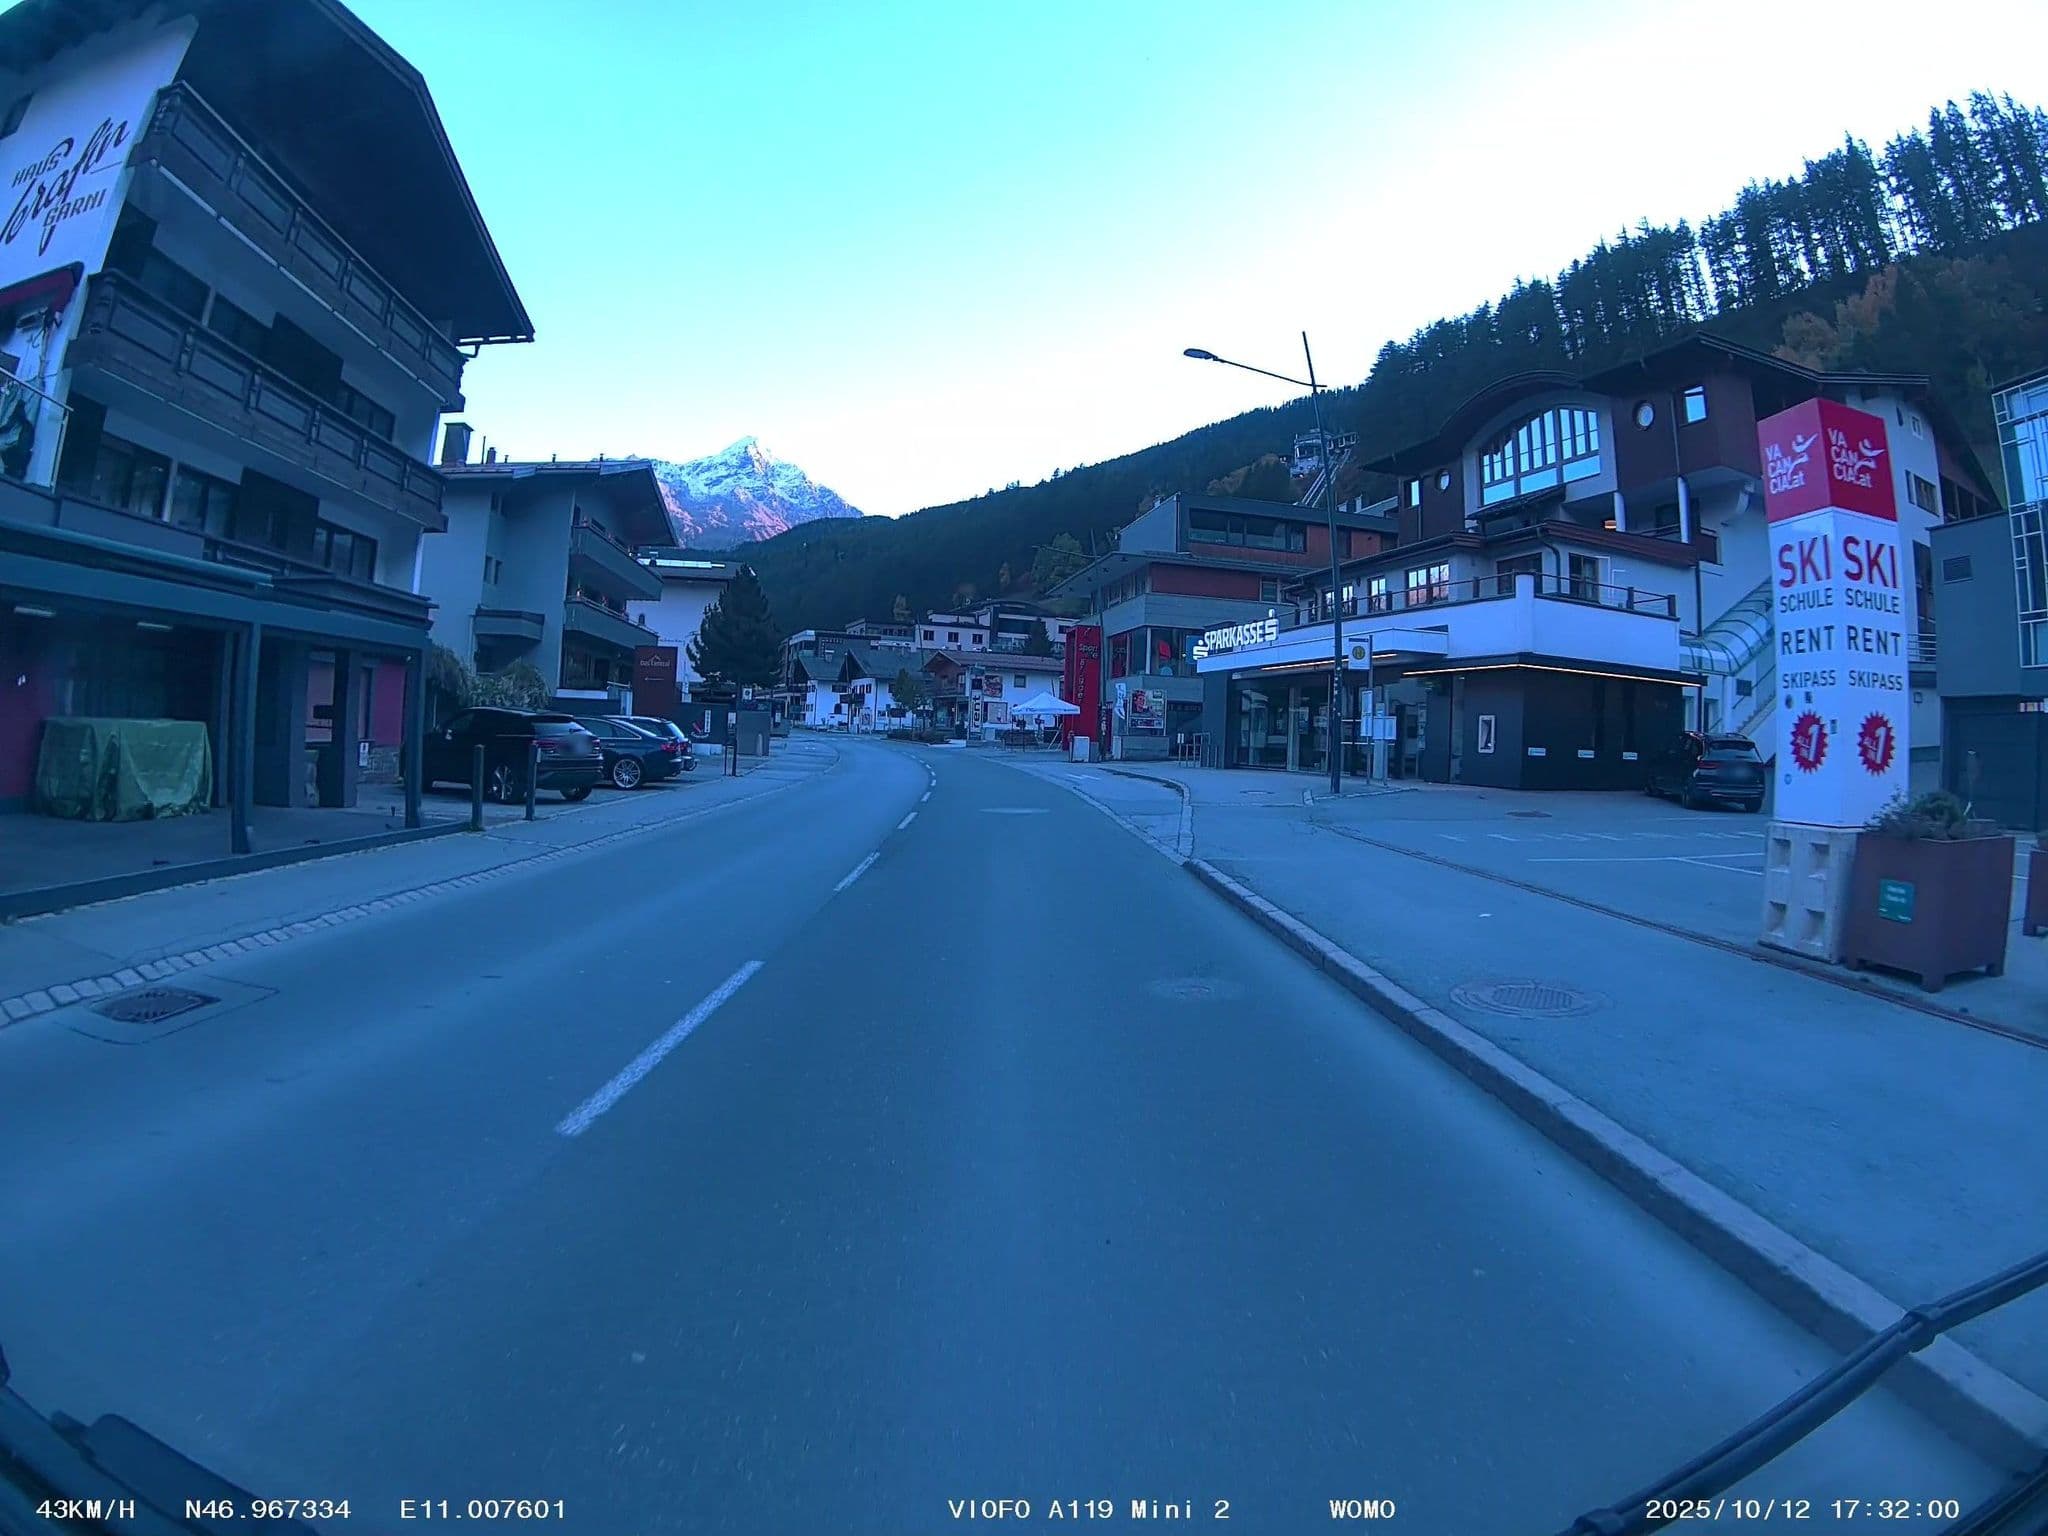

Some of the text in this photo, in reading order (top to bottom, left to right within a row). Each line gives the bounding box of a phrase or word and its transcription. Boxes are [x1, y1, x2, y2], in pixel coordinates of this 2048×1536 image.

[11, 152, 62, 188] HAUS
[43, 188, 107, 227] GARNI
[1778, 534, 1831, 588] SKI
[1843, 535, 1897, 588] SKI
[1780, 587, 1833, 613] SCHULE
[1845, 588, 1900, 614] SCHULE
[1204, 620, 1264, 650] SPARKASSE
[1781, 625, 1834, 655] RENT
[1847, 625, 1901, 656] RENT
[1782, 669, 1836, 689] SKIPASS
[1849, 669, 1903, 691] SKIPASS
[972, 695, 981, 728] rent
